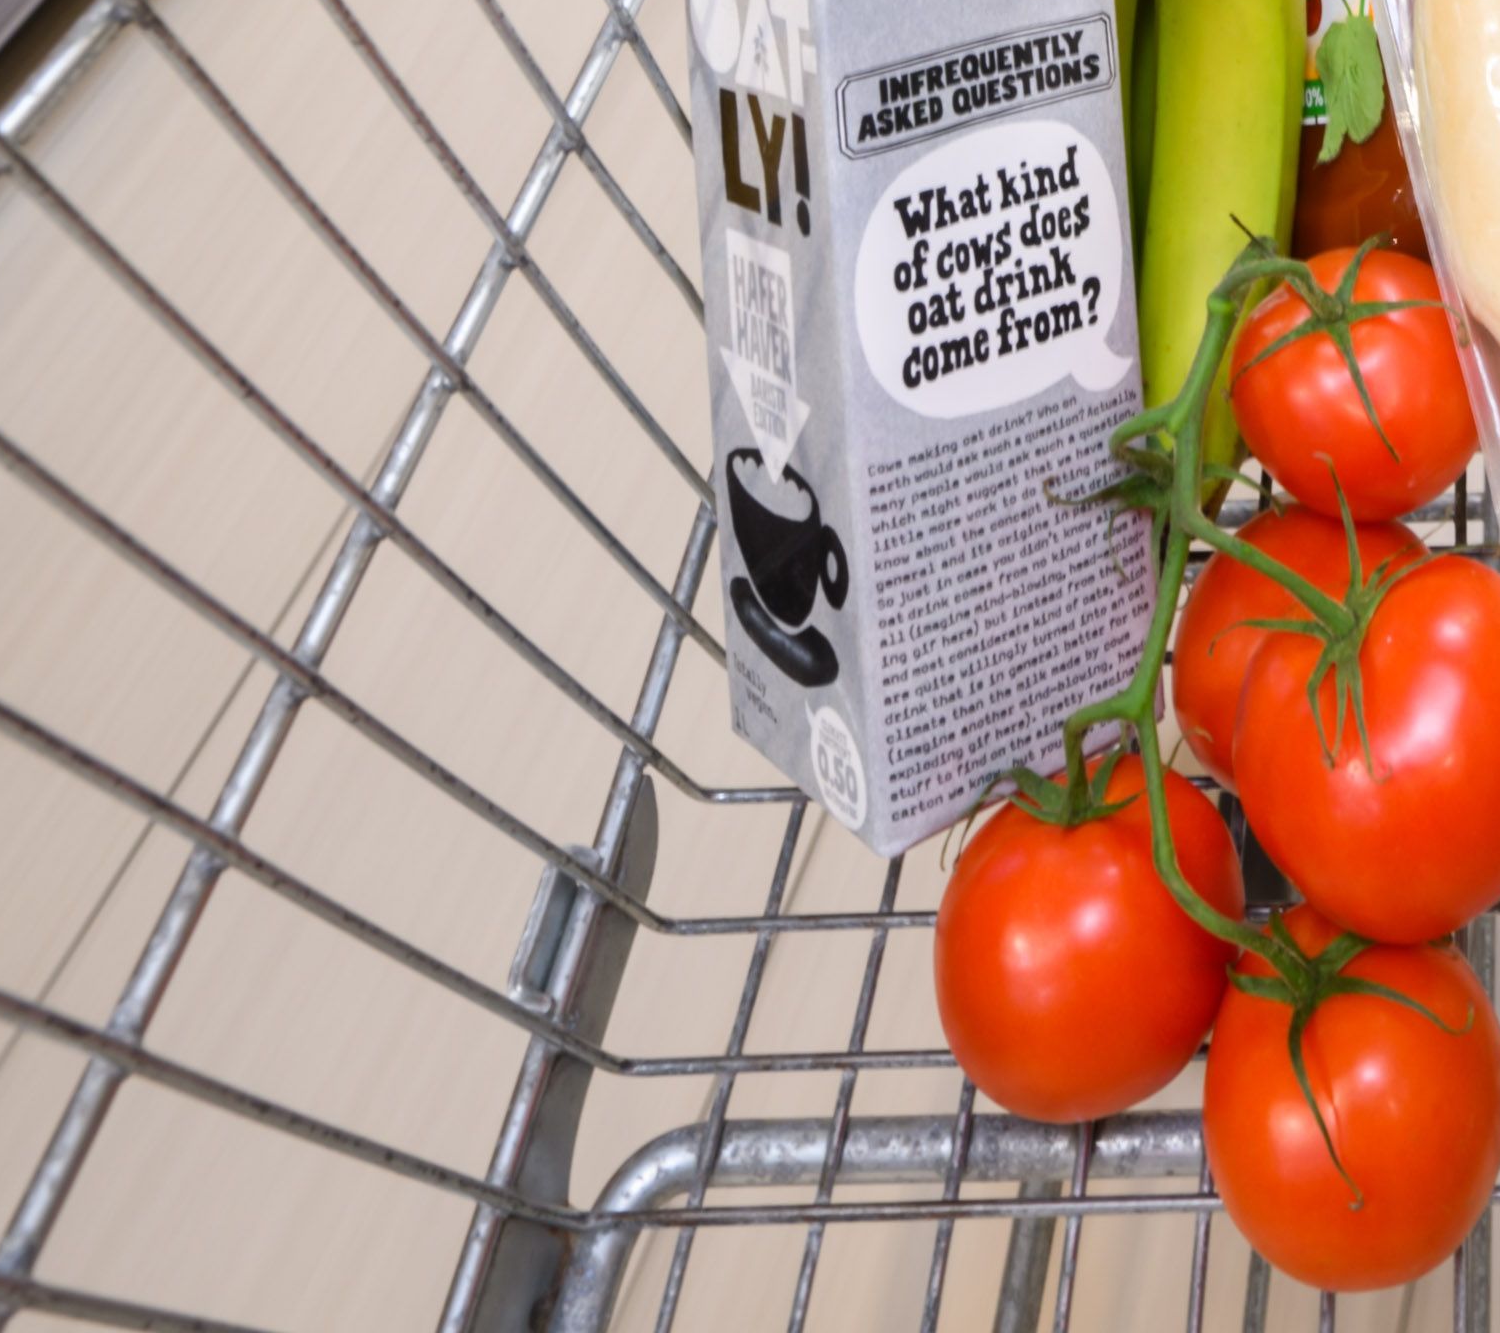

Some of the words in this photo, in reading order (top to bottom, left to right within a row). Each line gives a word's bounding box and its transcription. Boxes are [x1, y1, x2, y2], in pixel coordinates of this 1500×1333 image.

[857, 95, 943, 144] ASKED
[952, 53, 1100, 115] QUESTIONS
[879, 30, 1083, 106] INFREQUENTLY
[719, 87, 811, 238] LY!
[893, 174, 992, 238] What
[997, 145, 1080, 209] kind
[893, 239, 929, 292] of
[936, 221, 1012, 280] cows
[1019, 194, 1090, 247] does
[733, 254, 788, 330] HAFER
[902, 328, 989, 389] come
[997, 276, 1101, 356] from?
[908, 282, 965, 335] oat
[974, 246, 1076, 314] drink
[737, 307, 792, 385] HAVER
[867, 458, 902, 478] Cows
[908, 440, 958, 465] making
[962, 427, 984, 447] oat
[1036, 401, 1059, 419] Who
[1062, 395, 1076, 410] on
[869, 472, 910, 495] earth
[914, 457, 952, 483] would
[956, 448, 978, 468] ask
[982, 435, 1011, 458] such
[1014, 435, 1021, 446] a
[869, 496, 905, 514] many
[911, 477, 959, 506] people
[964, 458, 1003, 485] would
[1008, 447, 1029, 468] ask
[1034, 434, 1063, 457] such
[1068, 432, 1075, 444] a
[871, 509, 916, 534] which
[920, 493, 960, 520] might
[966, 471, 1018, 503] suggest
[1024, 457, 1052, 480] that
[1057, 452, 1071, 467] we
[1075, 439, 1103, 459] have
[874, 529, 923, 553] little
[928, 515, 961, 536] more
[966, 498, 996, 522] work
[1002, 493, 1016, 508] to
[1021, 485, 1036, 501] do
[874, 553, 910, 573] know
[915, 533, 955, 560] about
[961, 525, 984, 543] the
[989, 499, 1041, 532] concept
[1065, 480, 1086, 501] oat
[1089, 465, 1121, 491] drink
[876, 560, 935, 595] general
[941, 549, 965, 570] and
[971, 541, 992, 559] its
[997, 519, 1049, 549] origins
[1054, 510, 1068, 525] in
[877, 596, 894, 611] So
[899, 581, 930, 607] just
[935, 576, 952, 592] in
[957, 563, 988, 584] case
[993, 552, 1015, 573] you
[1019, 529, 1059, 559] didn't
[1063, 518, 1091, 539] know
[878, 609, 903, 629] oat
[907, 594, 949, 620] drink
[954, 580, 992, 604] comes
[998, 564, 1028, 586] from
[1032, 556, 1047, 572] no
[1051, 538, 1080, 563] kind
[1084, 530, 1097, 549] of
[879, 628, 904, 648] all
[880, 651, 907, 669] ing
[912, 638, 936, 662] gif
[984, 608, 1007, 630] but
[1011, 584, 1062, 619] instead
[1066, 572, 1095, 594] from
[1121, 543, 1145, 567] best
[882, 666, 908, 686] and
[912, 654, 944, 677] most
[948, 621, 1029, 664] considerate
[1032, 603, 1061, 629] kind
[1065, 595, 1078, 614] of
[883, 689, 909, 707] are
[914, 672, 955, 700] quite
[960, 641, 1027, 679] willingly
[1032, 615, 1075, 647] turned
[1079, 603, 1107, 625] into
[1111, 594, 1124, 610] an
[1127, 580, 1145, 601] oat
[884, 699, 927, 726] drink
[932, 685, 963, 709] that
[969, 679, 984, 695] is
[988, 670, 1004, 686] in
[1008, 642, 1059, 681] general
[1063, 624, 1104, 652] better
[1109, 612, 1128, 630] for
[1131, 600, 1149, 619] the
[885, 714, 946, 745] climate
[952, 698, 984, 721] than
[989, 686, 1012, 705] the
[1016, 666, 1047, 693] milk
[1050, 654, 1081, 677] made
[1084, 646, 1099, 661] by
[1103, 629, 1130, 652] cows
[888, 746, 963, 783] exploding
[968, 730, 990, 756] gif
[1041, 689, 1085, 719] Pretty
[890, 775, 931, 802] stuff
[937, 770, 952, 785] to
[957, 751, 988, 777] find
[990, 745, 1006, 762] on
[1009, 733, 1031, 752] the
[1036, 717, 1066, 740] side
[961, 703, 1014, 736] another
[817, 743, 858, 806] 0.50
[891, 793, 943, 822] carton
[948, 785, 964, 800] we
[1040, 736, 1062, 759] you
